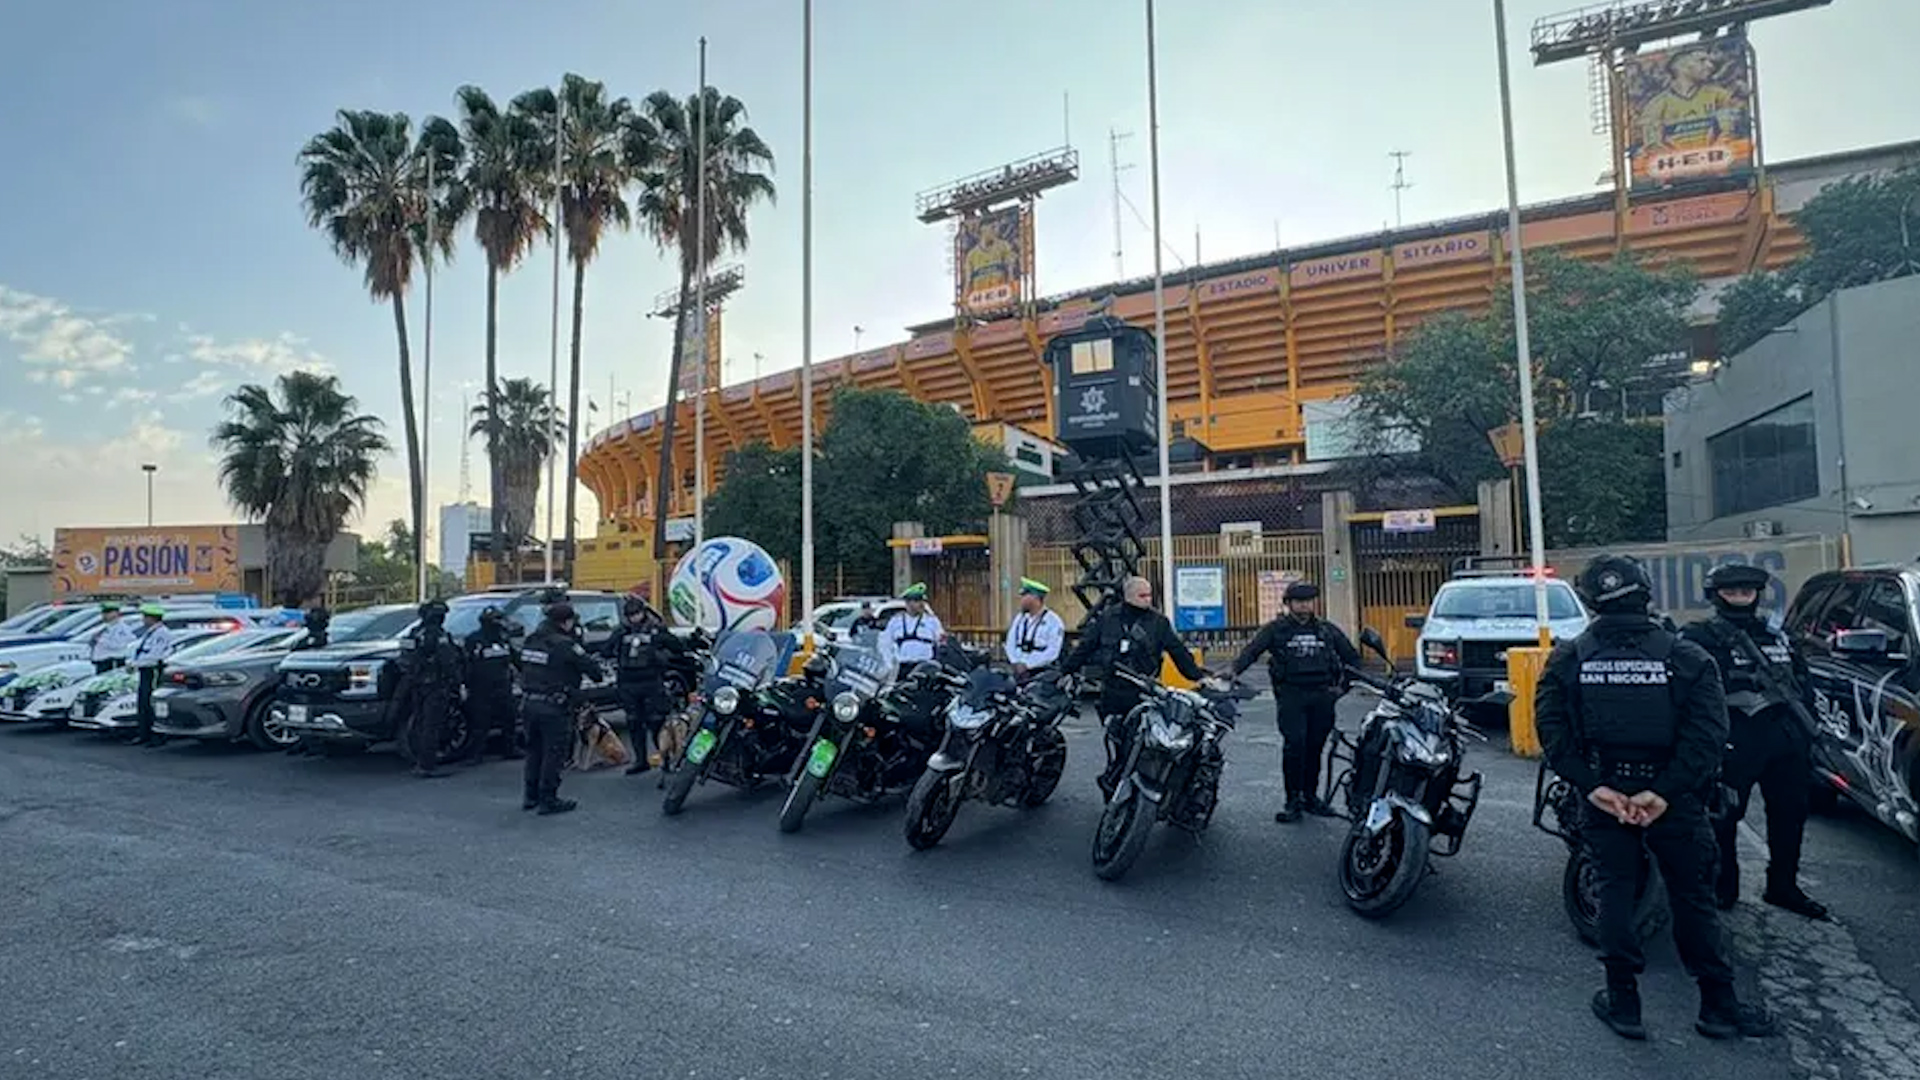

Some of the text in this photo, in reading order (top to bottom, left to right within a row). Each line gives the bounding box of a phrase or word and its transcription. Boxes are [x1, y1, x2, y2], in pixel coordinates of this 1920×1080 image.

[1210, 238, 1478, 295] ESTADIO UNIVER SITARIO
[105, 540, 189, 576] PASIÓN
[1580, 673, 1605, 685] SAN
